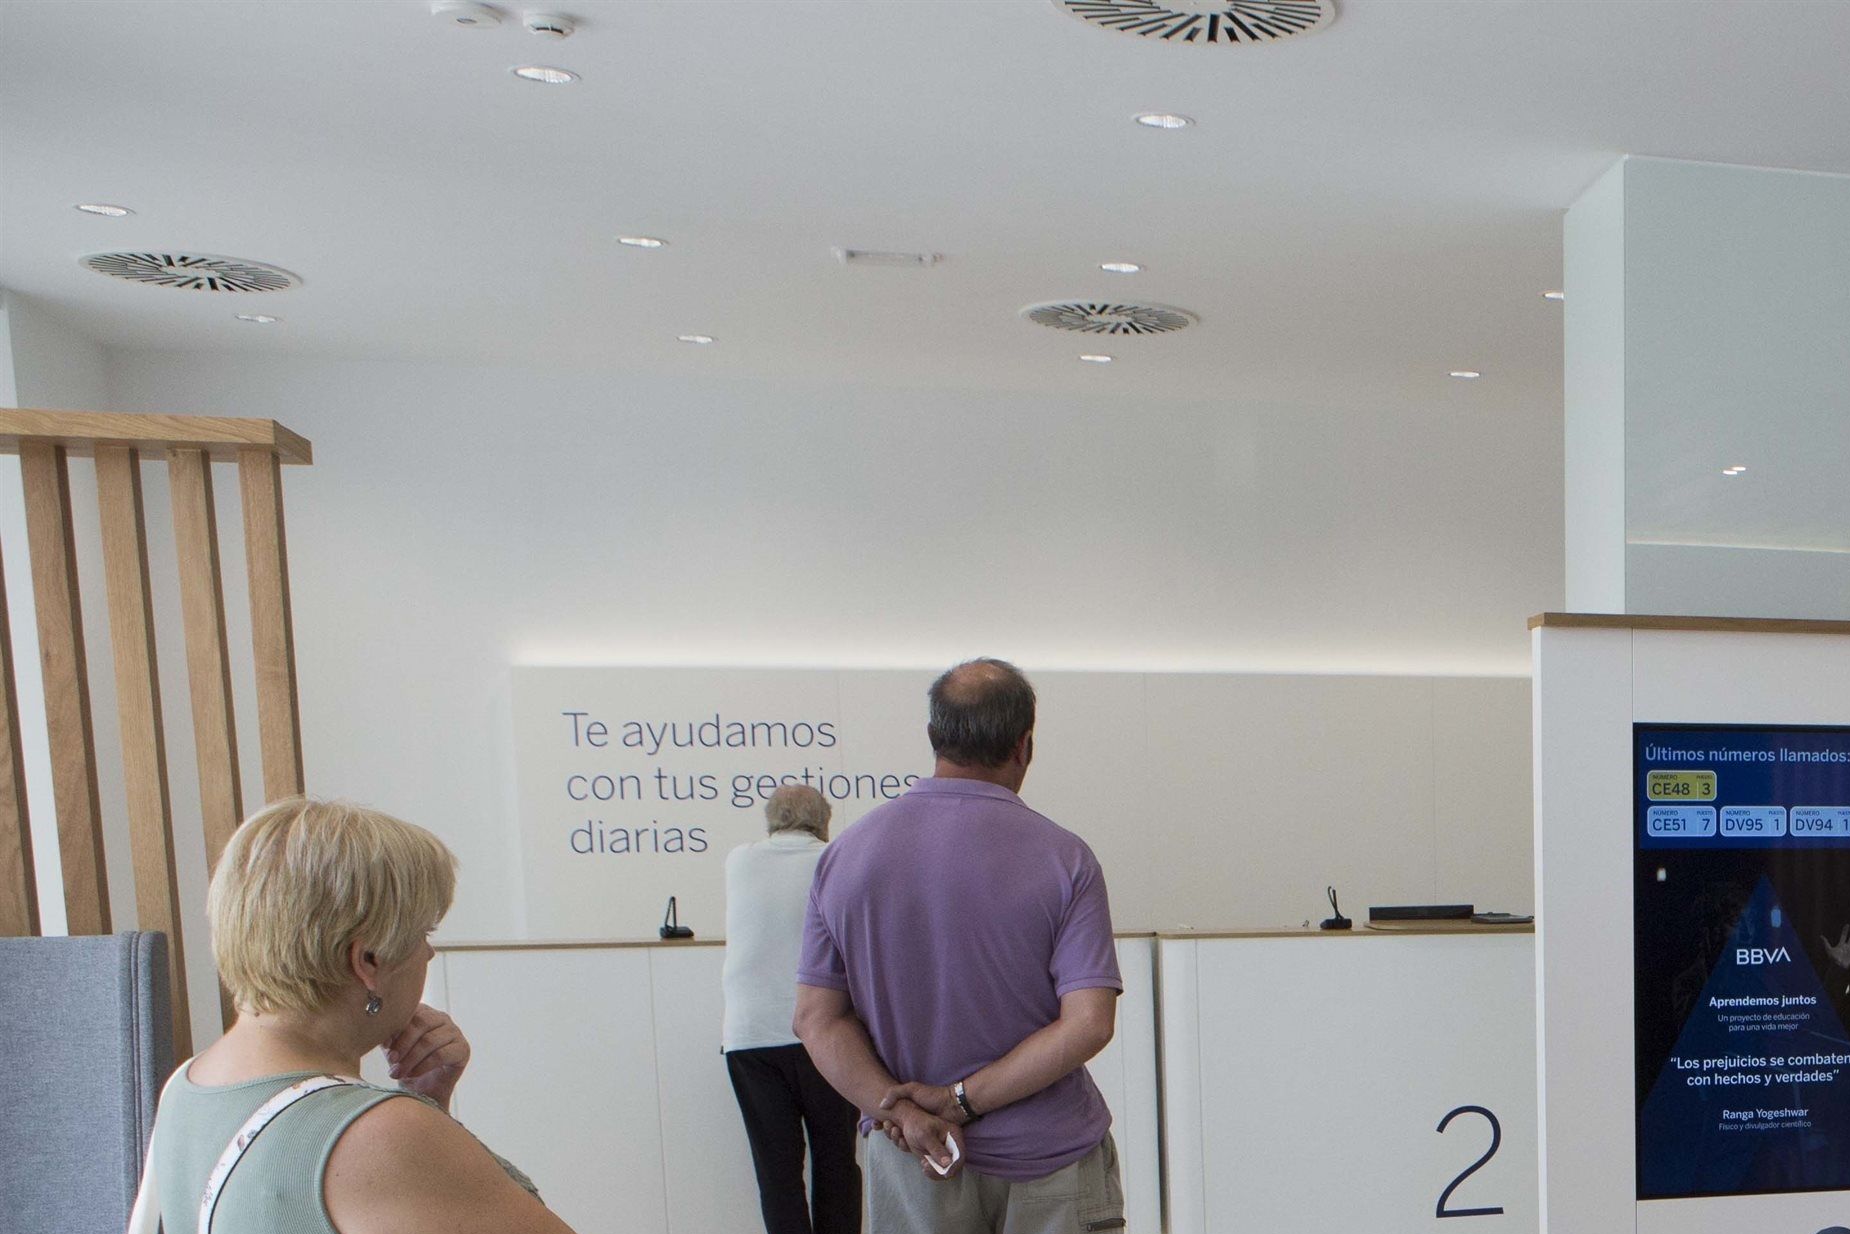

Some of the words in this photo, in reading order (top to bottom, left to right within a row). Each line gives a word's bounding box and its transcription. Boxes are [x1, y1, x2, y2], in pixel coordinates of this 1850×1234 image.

[562, 712, 608, 747] Te
[622, 713, 837, 755] ayudamos
[1645, 743, 1706, 761] Últimos
[1709, 746, 1775, 762] números
[1780, 748, 1850, 763] llamados:
[567, 774, 641, 800] con
[654, 767, 718, 800] tus
[1652, 782, 1690, 796] CE48
[1702, 782, 1711, 796] 3
[1652, 818, 1686, 831] CE51
[1702, 818, 1711, 831] 7
[1725, 818, 1763, 831] DV95
[1774, 818, 1780, 831] 1
[1795, 818, 1834, 831] DV94
[1843, 818, 1849, 831] 1
[570, 819, 709, 854] diarias
[1736, 946, 1791, 965] BBVA
[1709, 996, 1779, 1009] Aprendemos
[1781, 994, 1817, 1007] juntos
[1717, 1014, 1728, 1022] Un
[1729, 1013, 1761, 1023] proyecto
[1762, 1013, 1772, 1021] de
[1729, 1024, 1746, 1032] para
[1761, 1022, 1777, 1030] vida
[1778, 1023, 1799, 1031] mejor
[1703, 1055, 1767, 1070] prejuicios
[1770, 1057, 1785, 1066] se
[1687, 1076, 1711, 1086] con
[1714, 1072, 1761, 1085] hechos
[1764, 1074, 1772, 1086] y
[1722, 1109, 1754, 1120] Ranga
[1755, 1107, 1809, 1120] Yogeshwar
[1436, 1105, 1504, 1218] 2
